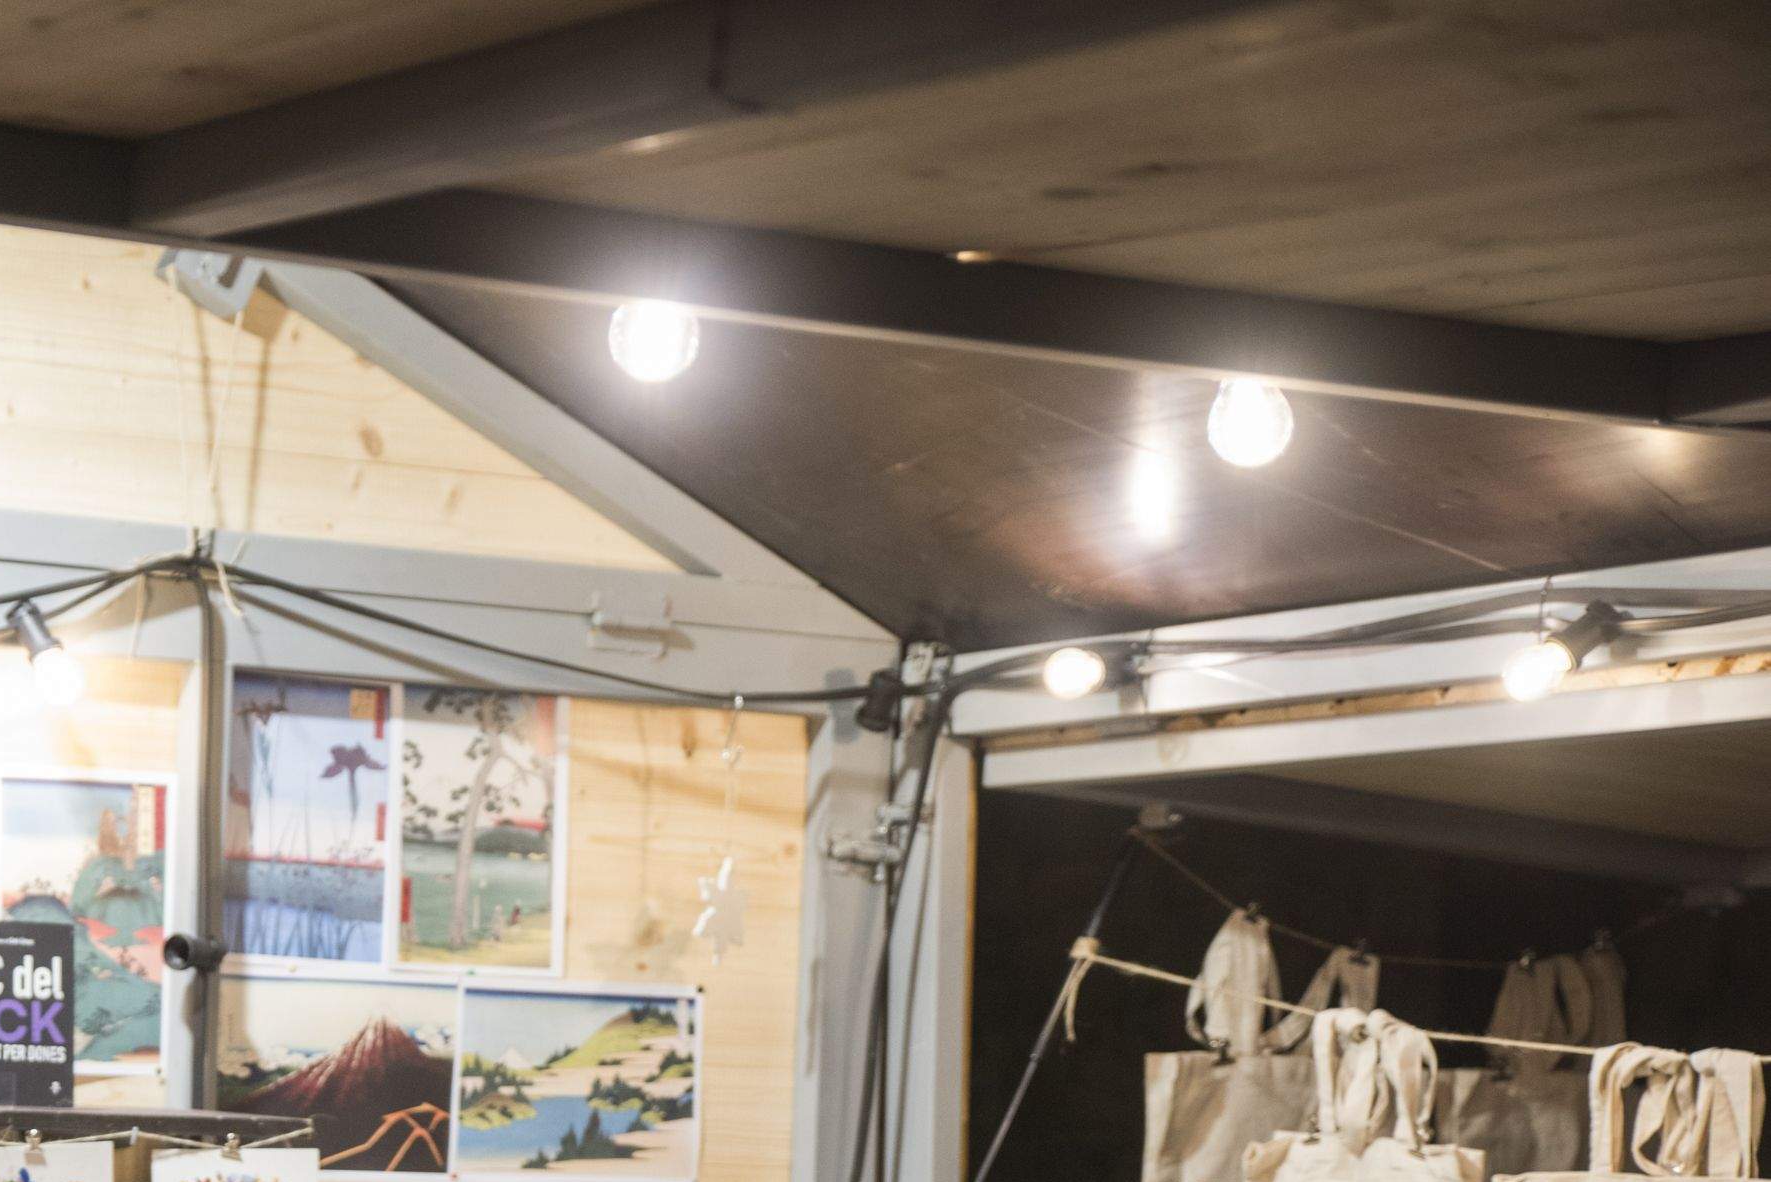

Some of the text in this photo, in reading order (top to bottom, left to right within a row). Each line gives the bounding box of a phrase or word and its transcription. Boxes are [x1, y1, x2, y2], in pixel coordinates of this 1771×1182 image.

[12, 953, 65, 1000] del
[3, 1044, 27, 1062] PER
[28, 1044, 67, 1063] DONES
